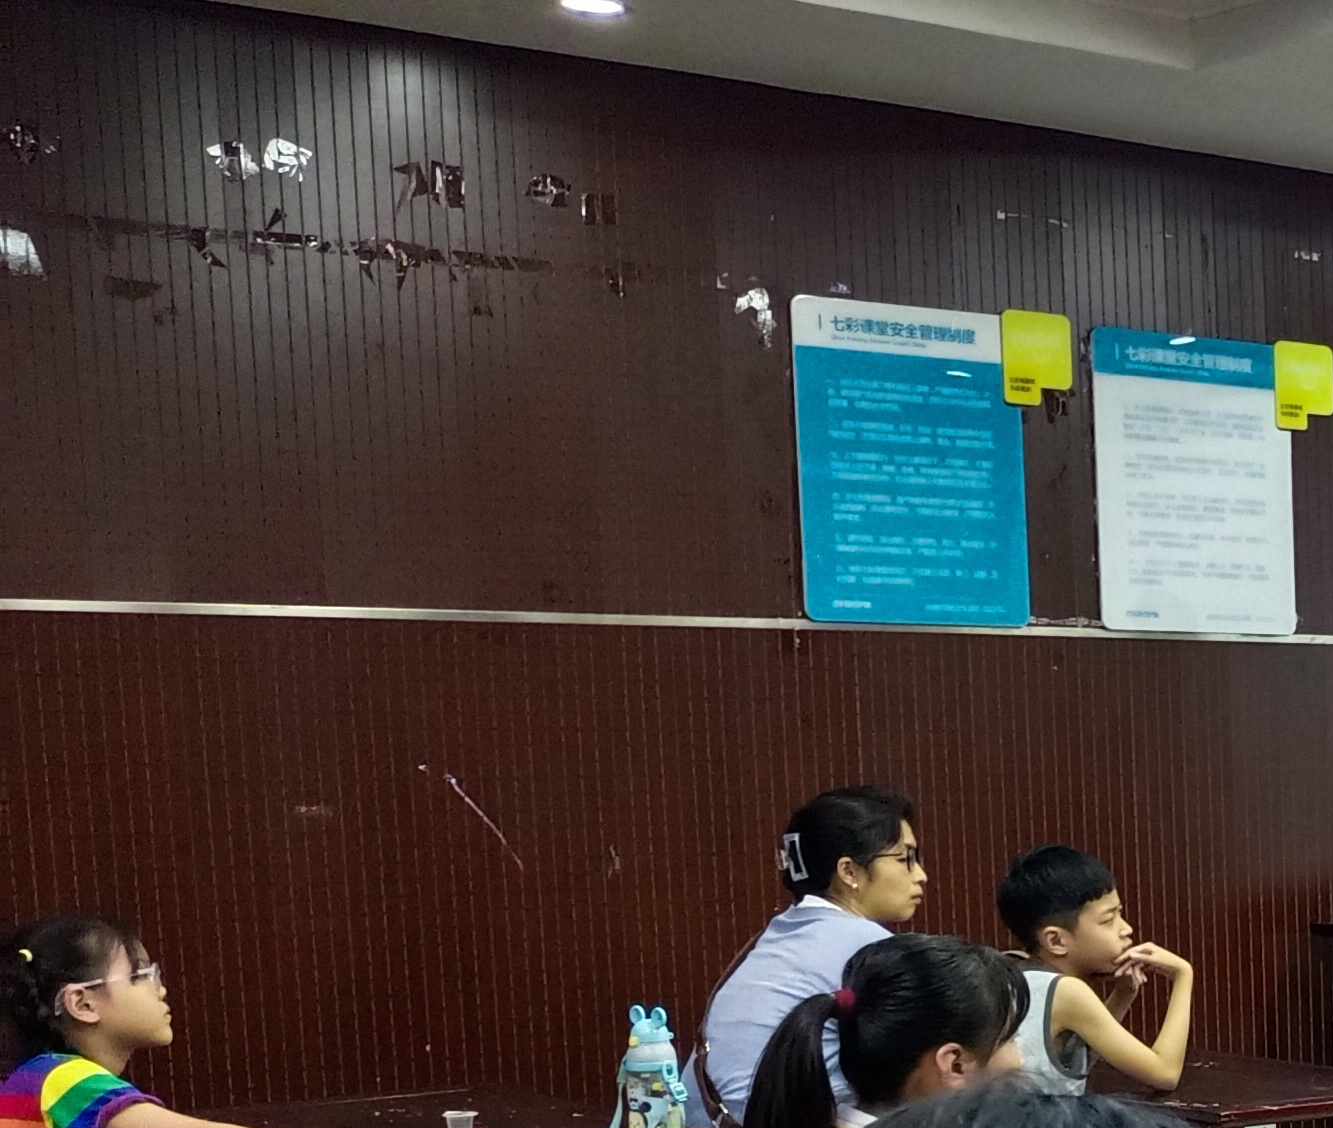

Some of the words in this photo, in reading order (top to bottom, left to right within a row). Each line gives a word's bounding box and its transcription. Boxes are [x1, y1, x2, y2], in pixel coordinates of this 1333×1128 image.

[830, 315, 977, 345] 七彩课堂安全管理制度
